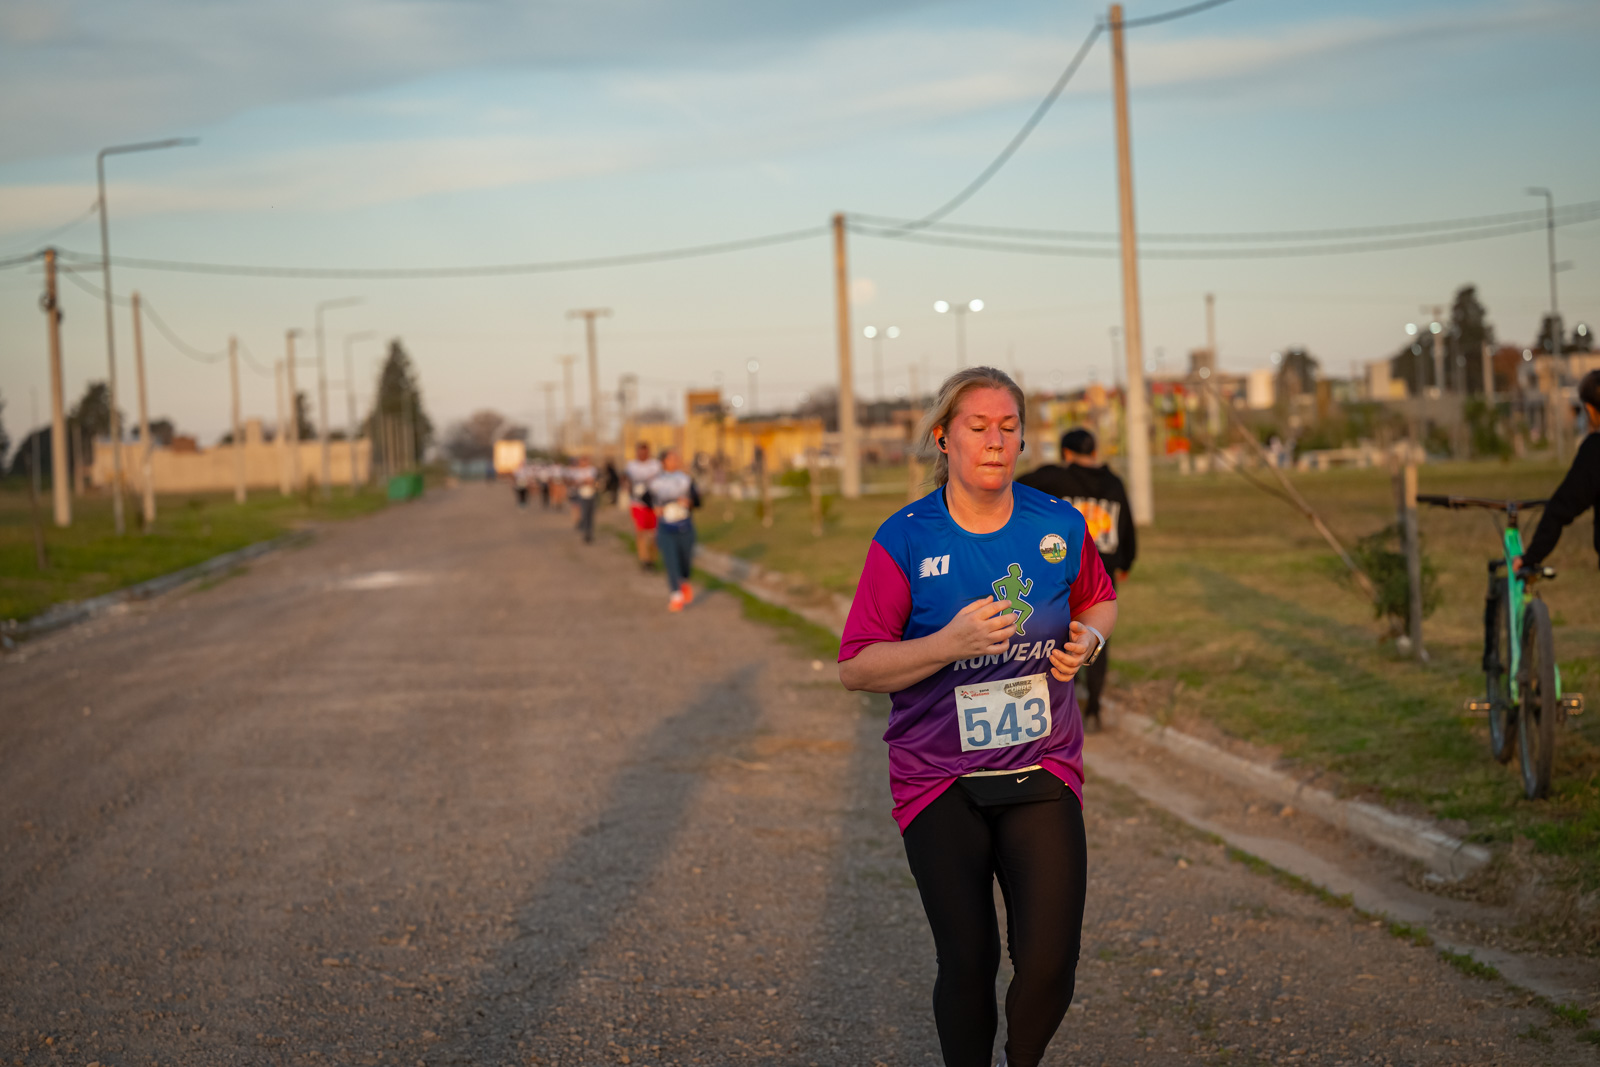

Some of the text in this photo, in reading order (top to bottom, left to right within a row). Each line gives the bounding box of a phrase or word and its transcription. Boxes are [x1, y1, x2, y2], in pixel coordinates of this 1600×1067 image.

[919, 554, 950, 579] K1
[1004, 679, 1032, 689] ALVAREZ
[963, 697, 1048, 747] 543
